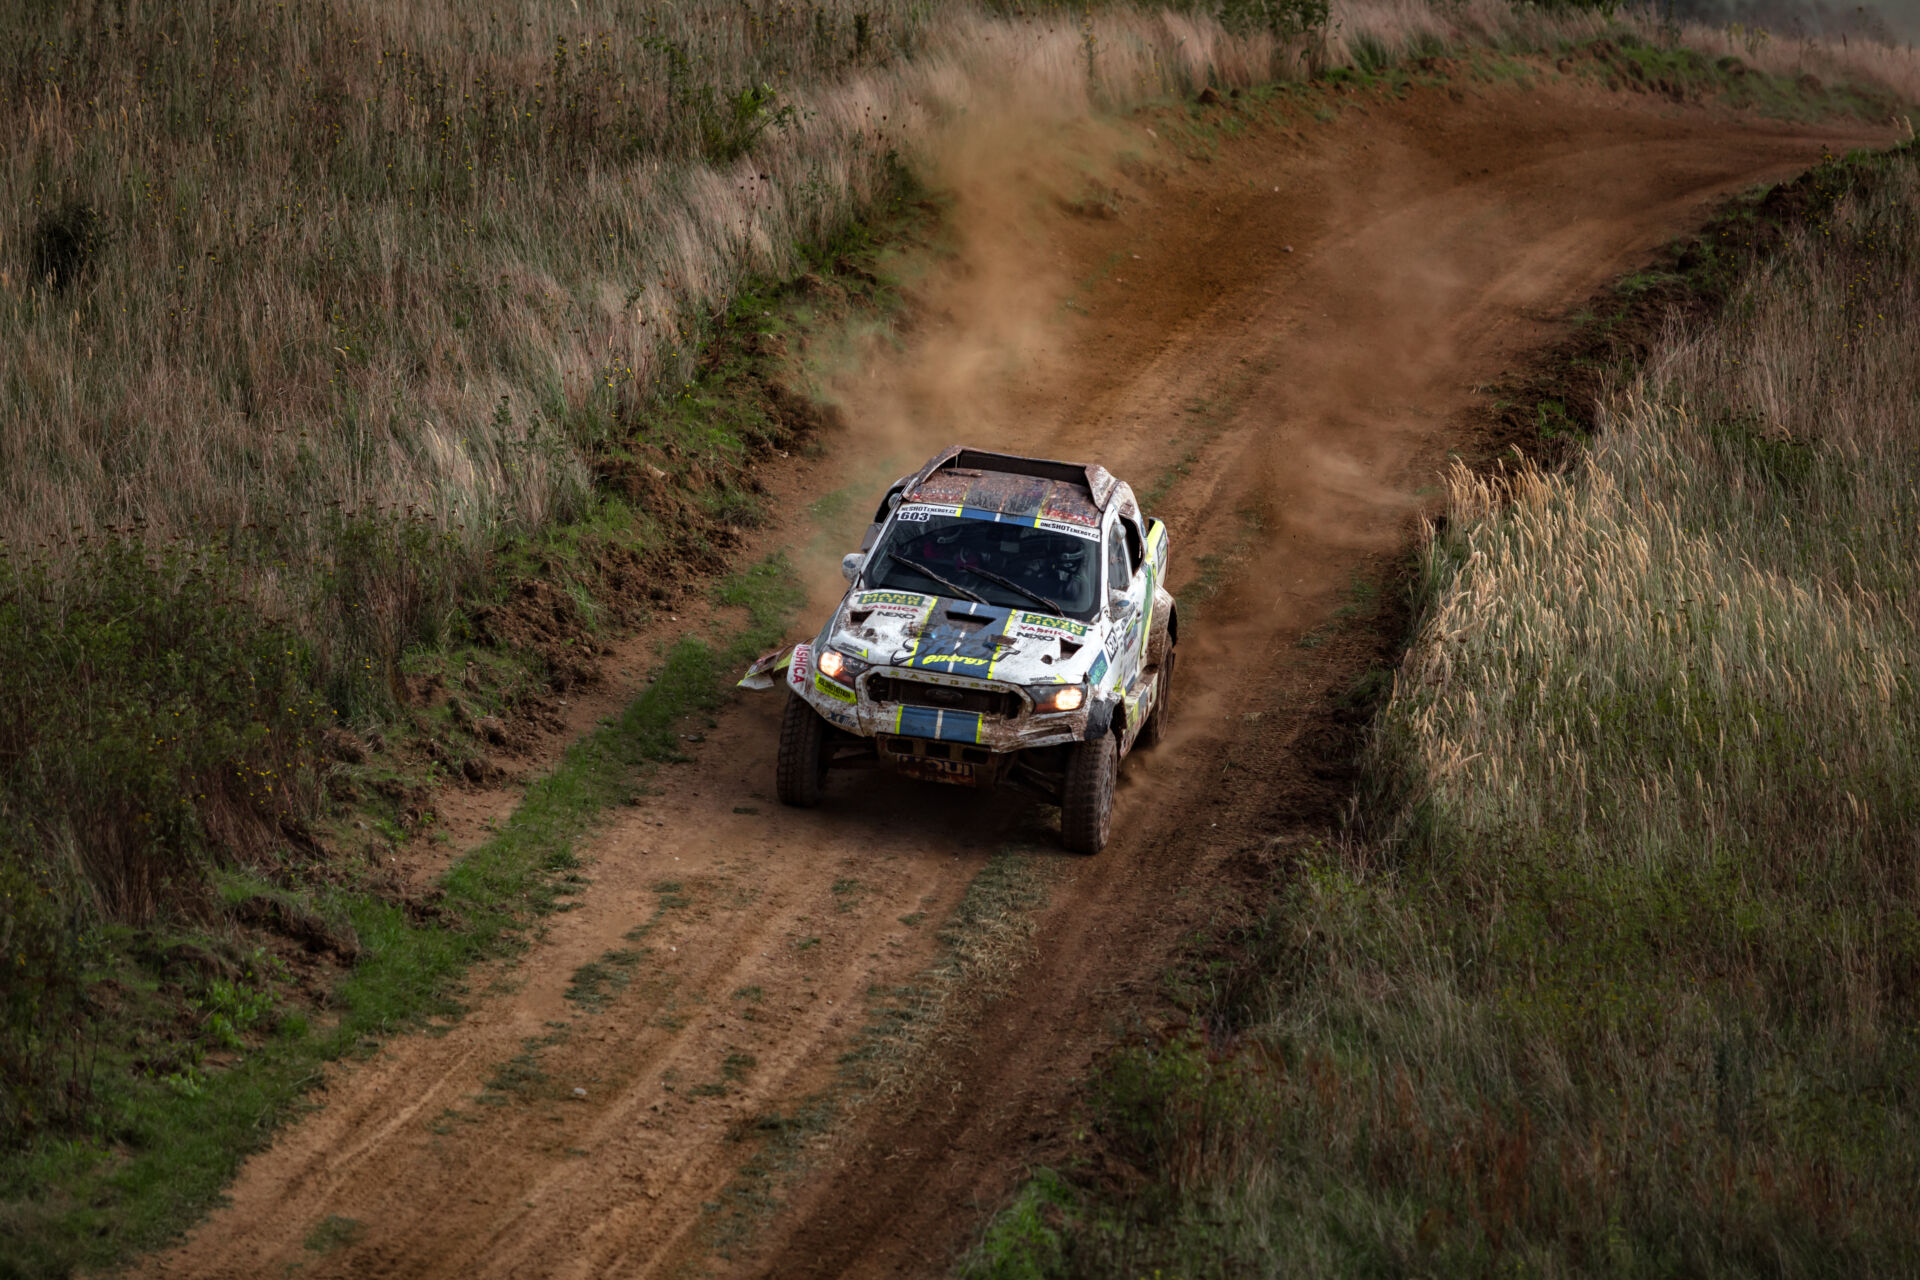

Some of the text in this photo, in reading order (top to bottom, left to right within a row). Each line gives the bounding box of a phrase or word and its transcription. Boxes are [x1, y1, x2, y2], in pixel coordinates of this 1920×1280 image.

[900, 511, 929, 521] 603
[863, 593, 921, 601] MANN
[877, 611, 916, 619] NEXO
[1025, 614, 1084, 631] MANN
[1016, 632, 1055, 641] NEXO
